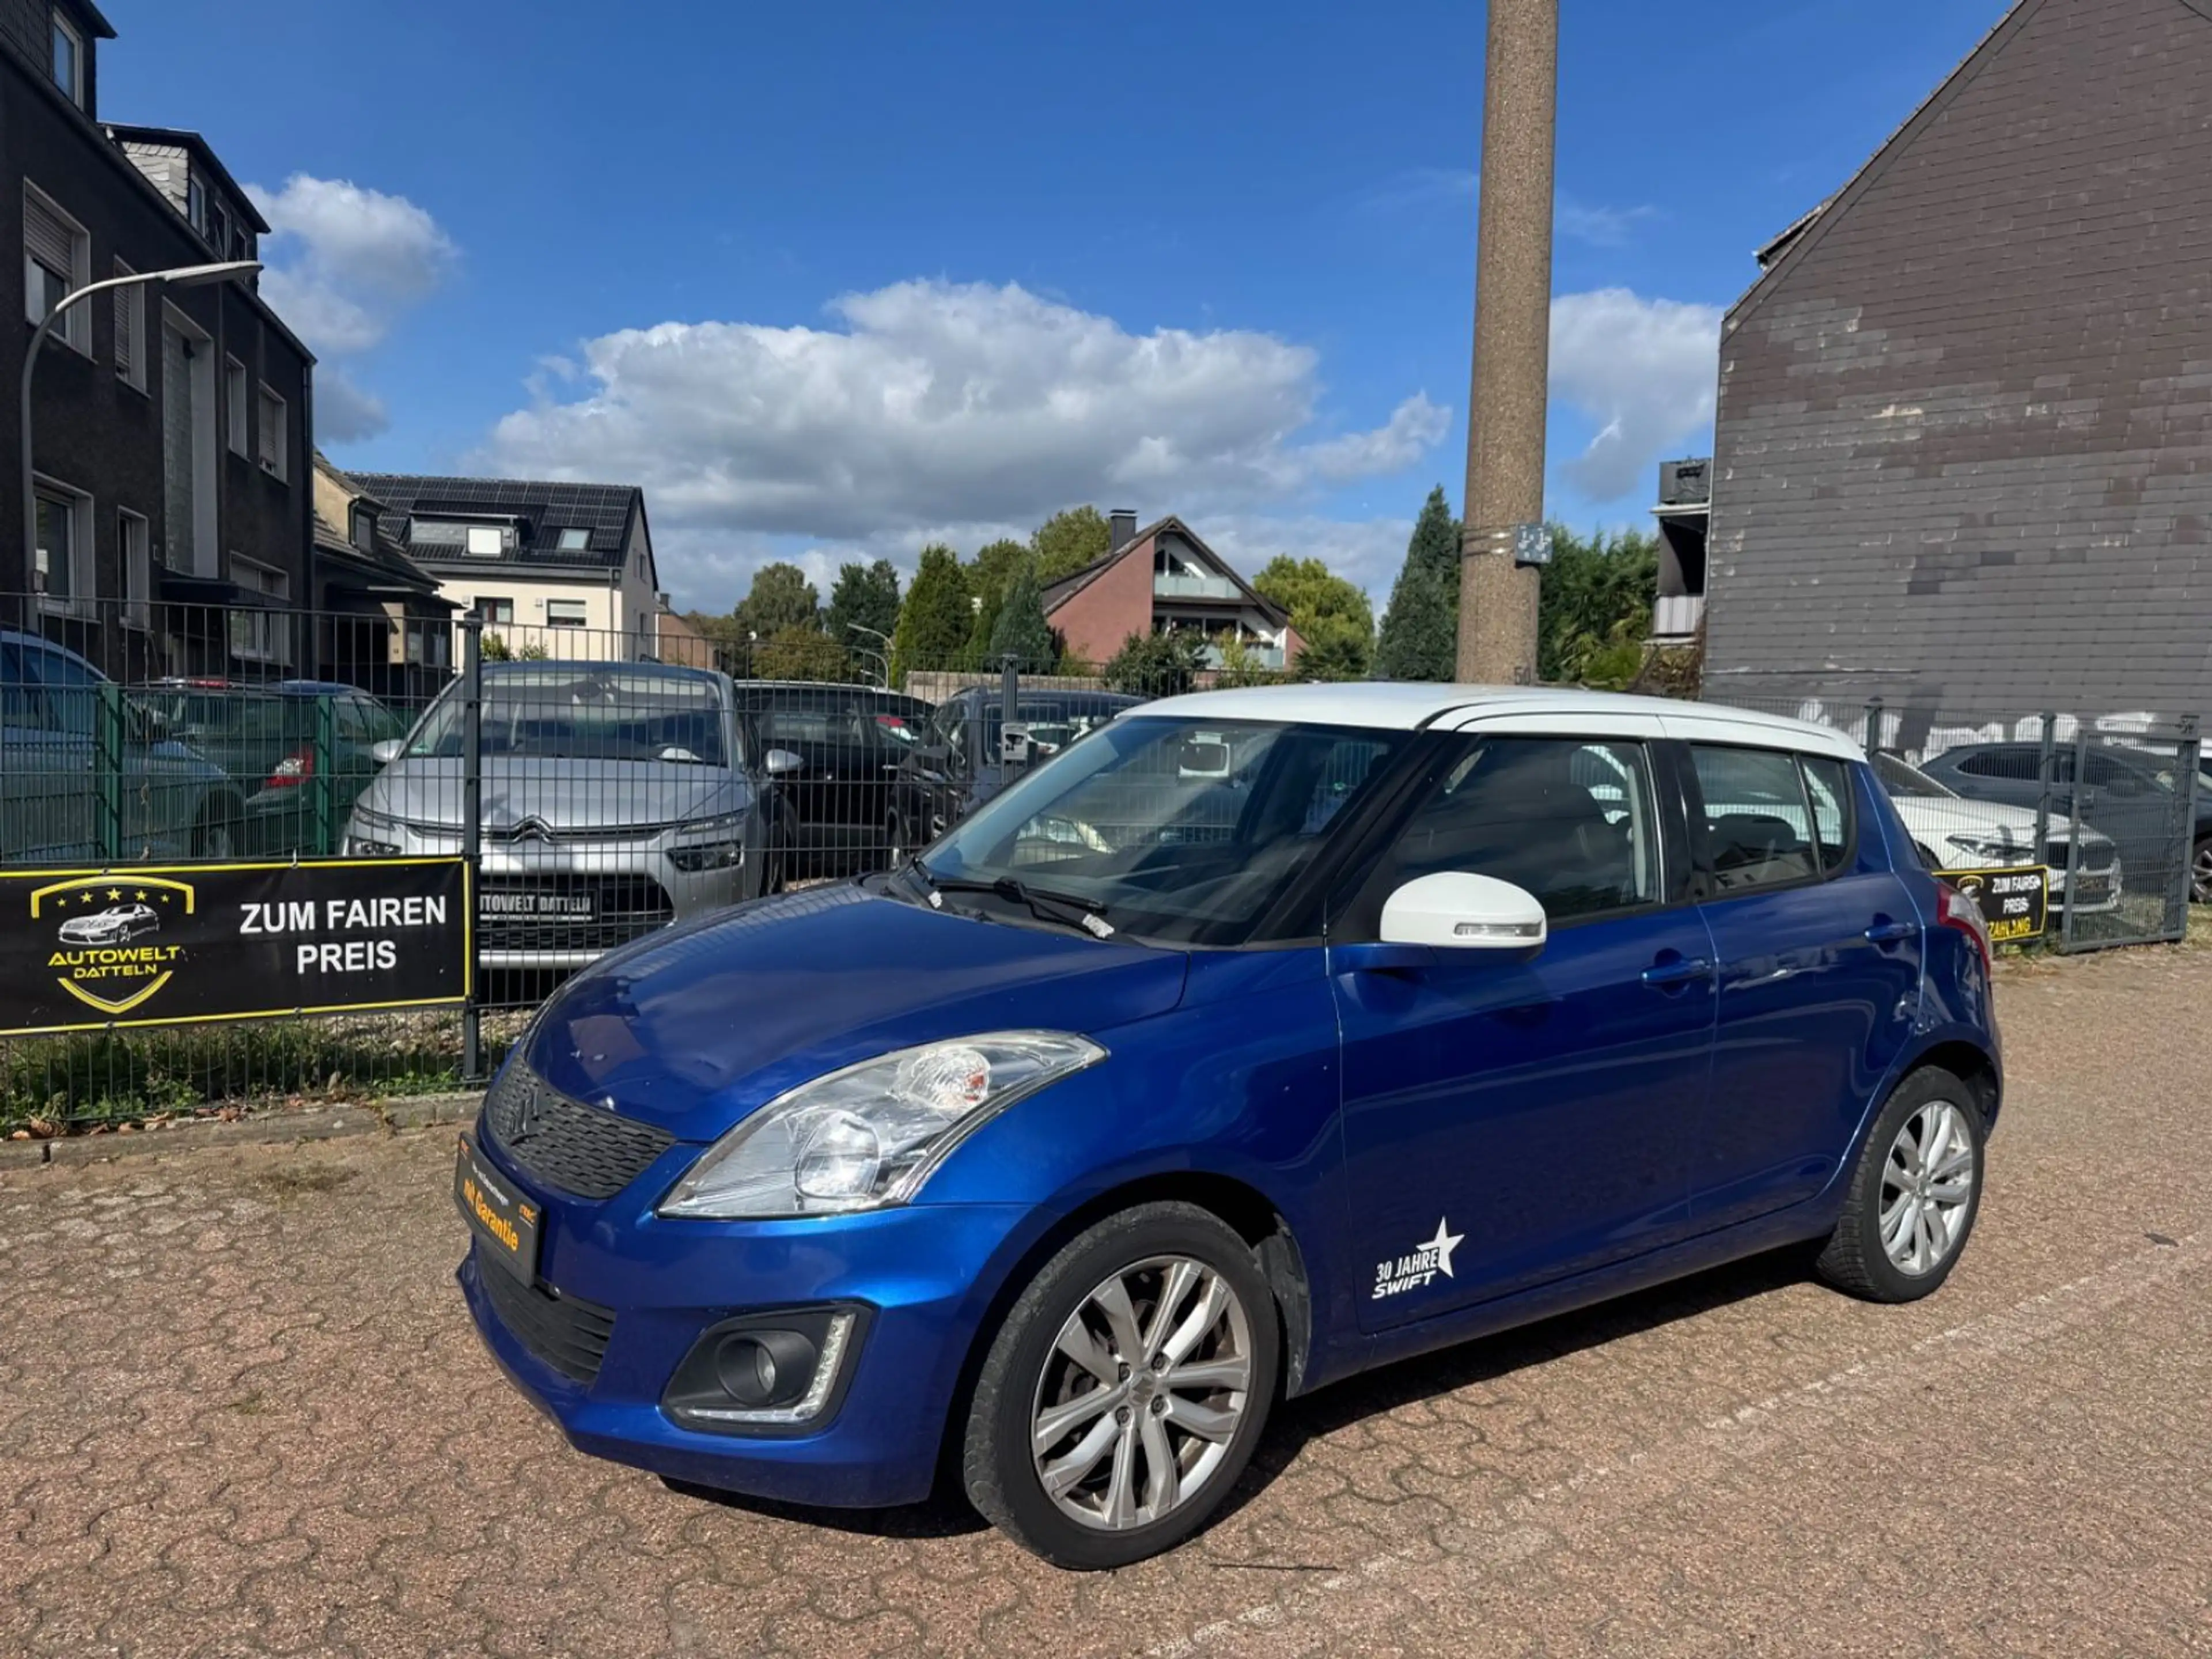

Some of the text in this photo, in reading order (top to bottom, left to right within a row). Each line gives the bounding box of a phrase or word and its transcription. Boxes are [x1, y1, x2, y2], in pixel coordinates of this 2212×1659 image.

[240, 895, 446, 934] ZUM FAIREN
[48, 945, 181, 967] AUTOWELT
[74, 964, 157, 979] DATTELN
[297, 940, 397, 975] PREIS
[475, 1190, 519, 1252] Garantie
[1375, 1248, 1438, 1283] 30 JAHRE
[1371, 1269, 1437, 1300] SWIFT
